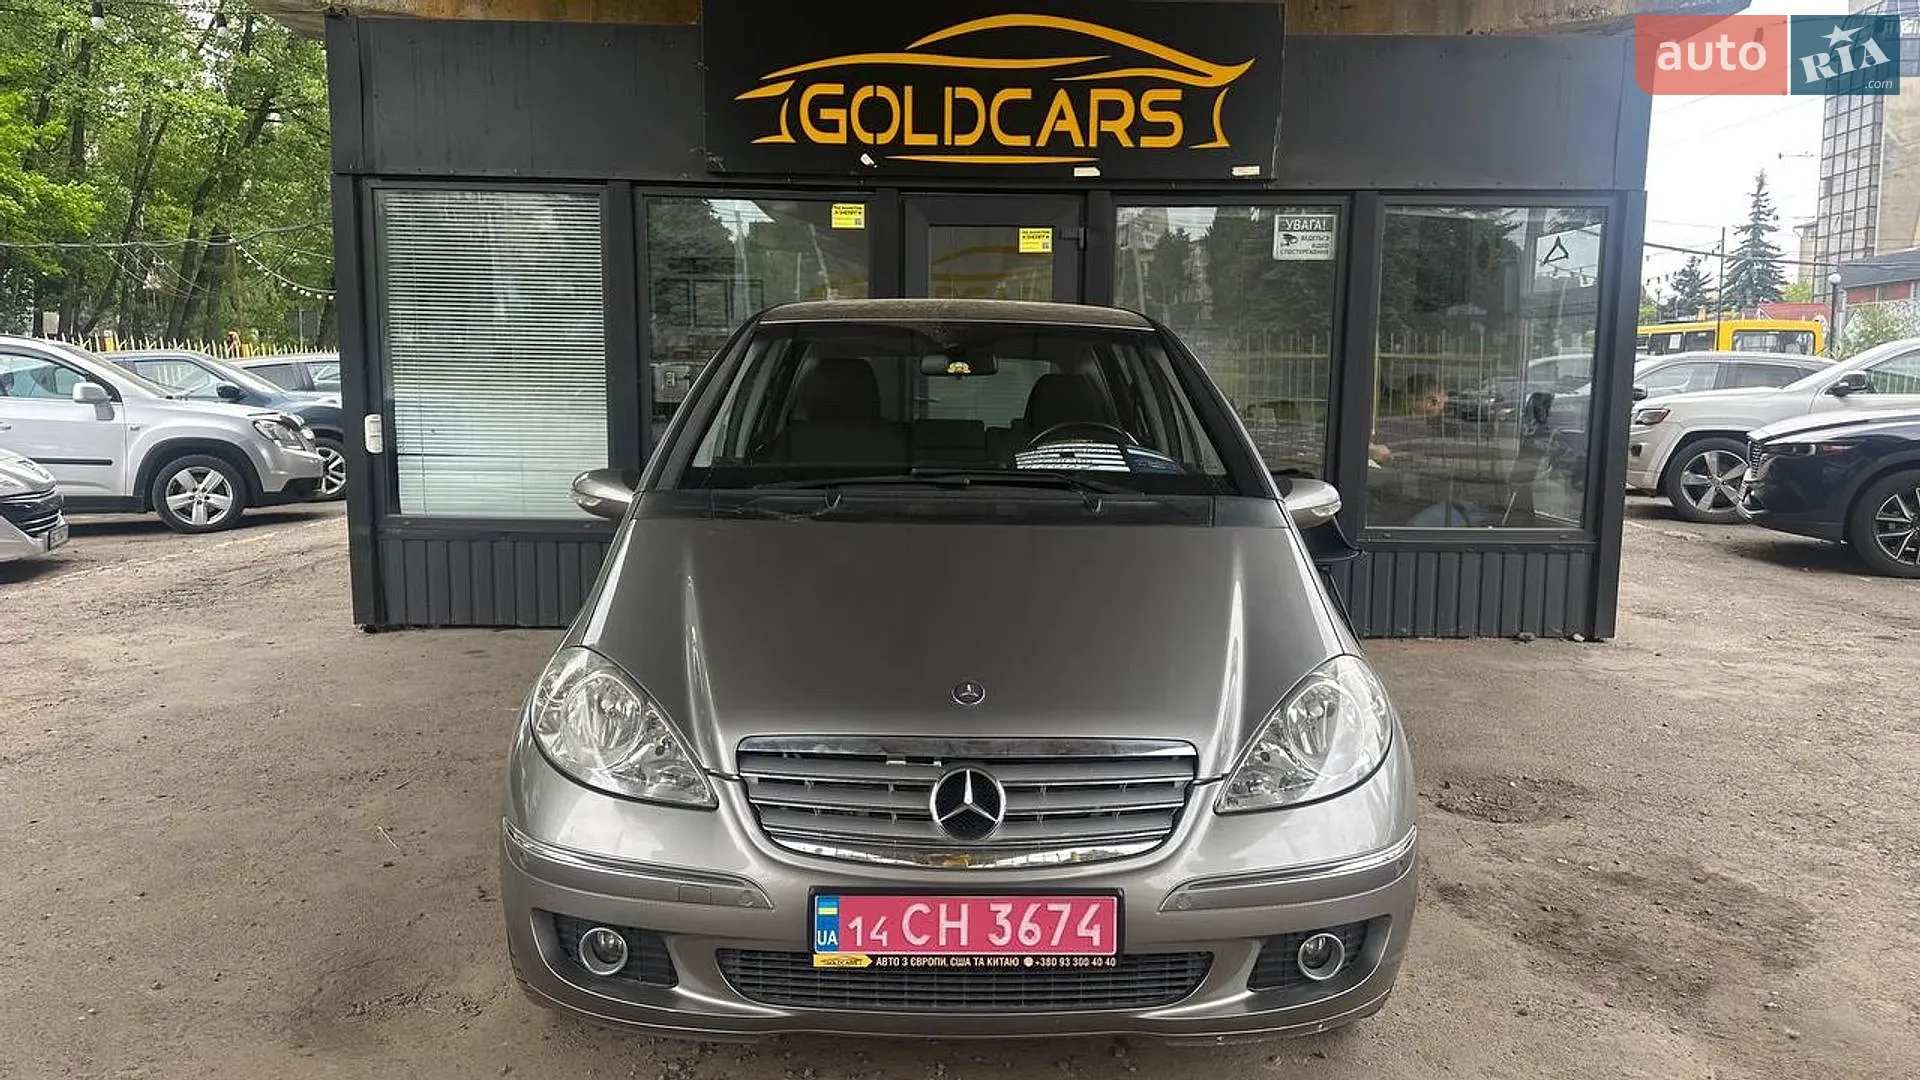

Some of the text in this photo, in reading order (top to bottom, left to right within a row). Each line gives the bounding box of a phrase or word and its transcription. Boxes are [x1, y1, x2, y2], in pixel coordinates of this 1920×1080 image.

[799, 83, 1184, 149] GOLDCARS
[1285, 219, 1326, 231] УВАГА!
[848, 916, 888, 947] 14
[988, 903, 1101, 947] 3674
[817, 930, 838, 946] UA
[875, 957, 900, 967] АВТО
[949, 957, 972, 967] США
[973, 957, 985, 967] ТА
[986, 957, 1020, 967] КИТАЮ
[1034, 957, 1058, 967] +380
[1058, 957, 1071, 967] 93
[1091, 957, 1103, 967] 40
[1105, 957, 1117, 967] 40
